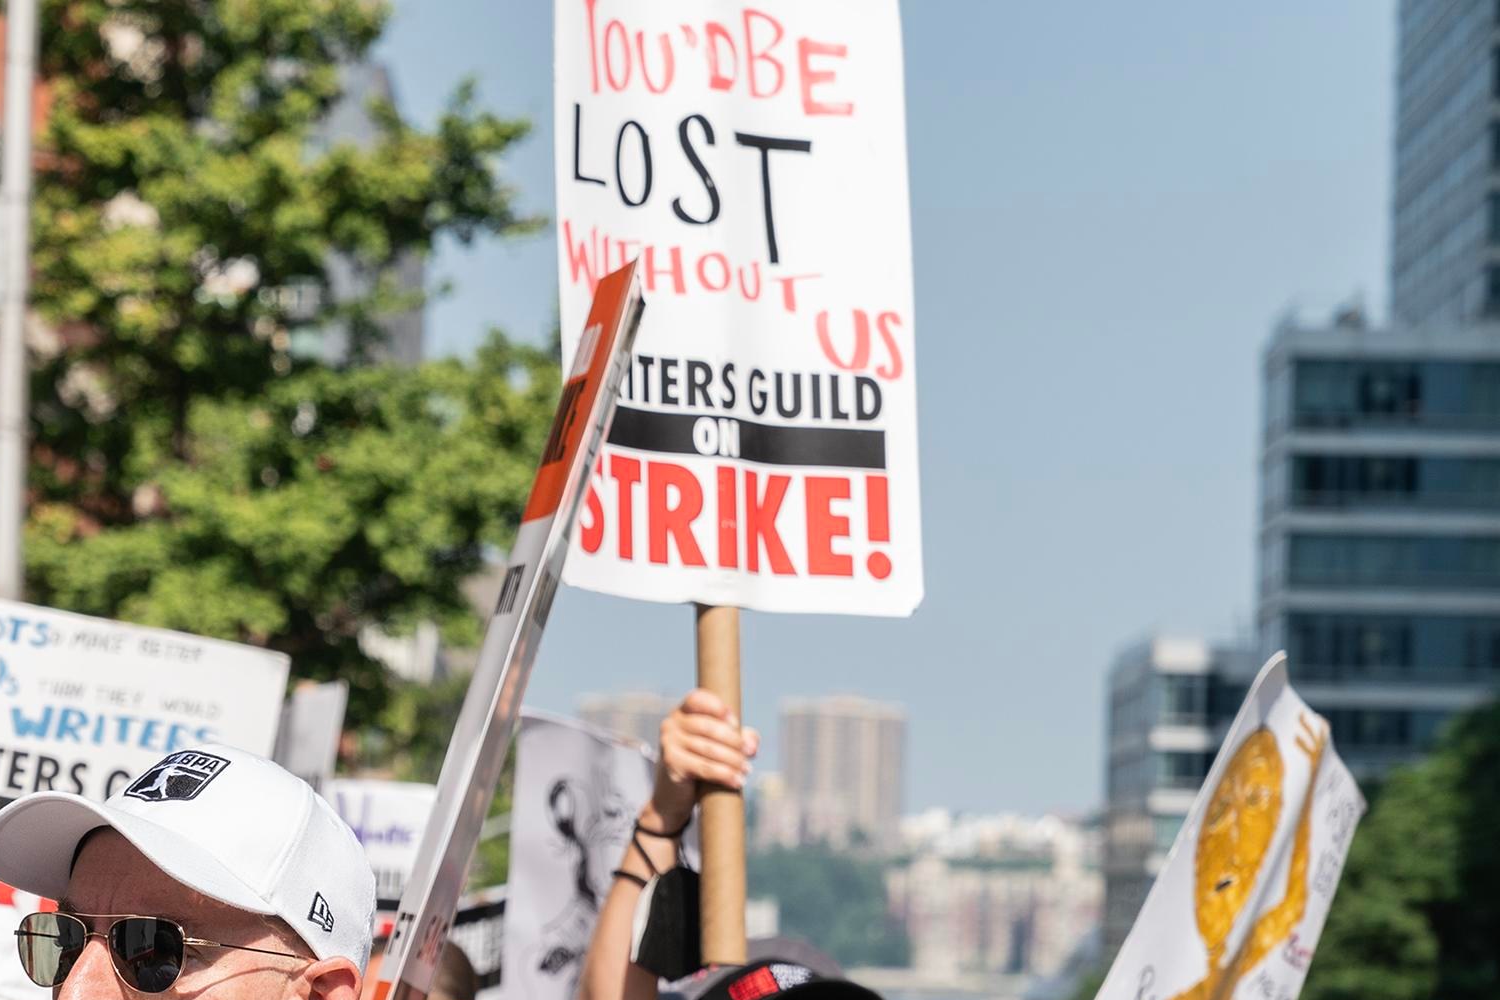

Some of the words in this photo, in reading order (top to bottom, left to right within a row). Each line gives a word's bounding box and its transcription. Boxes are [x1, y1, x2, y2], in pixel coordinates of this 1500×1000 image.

[573, 103, 812, 265] LOST
[564, 220, 823, 312] WITHOUT
[817, 308, 902, 382] US
[627, 355, 736, 410] ITERS
[749, 368, 883, 422] GUILD
[692, 417, 740, 458] ON
[580, 453, 894, 581] STRIKE!
